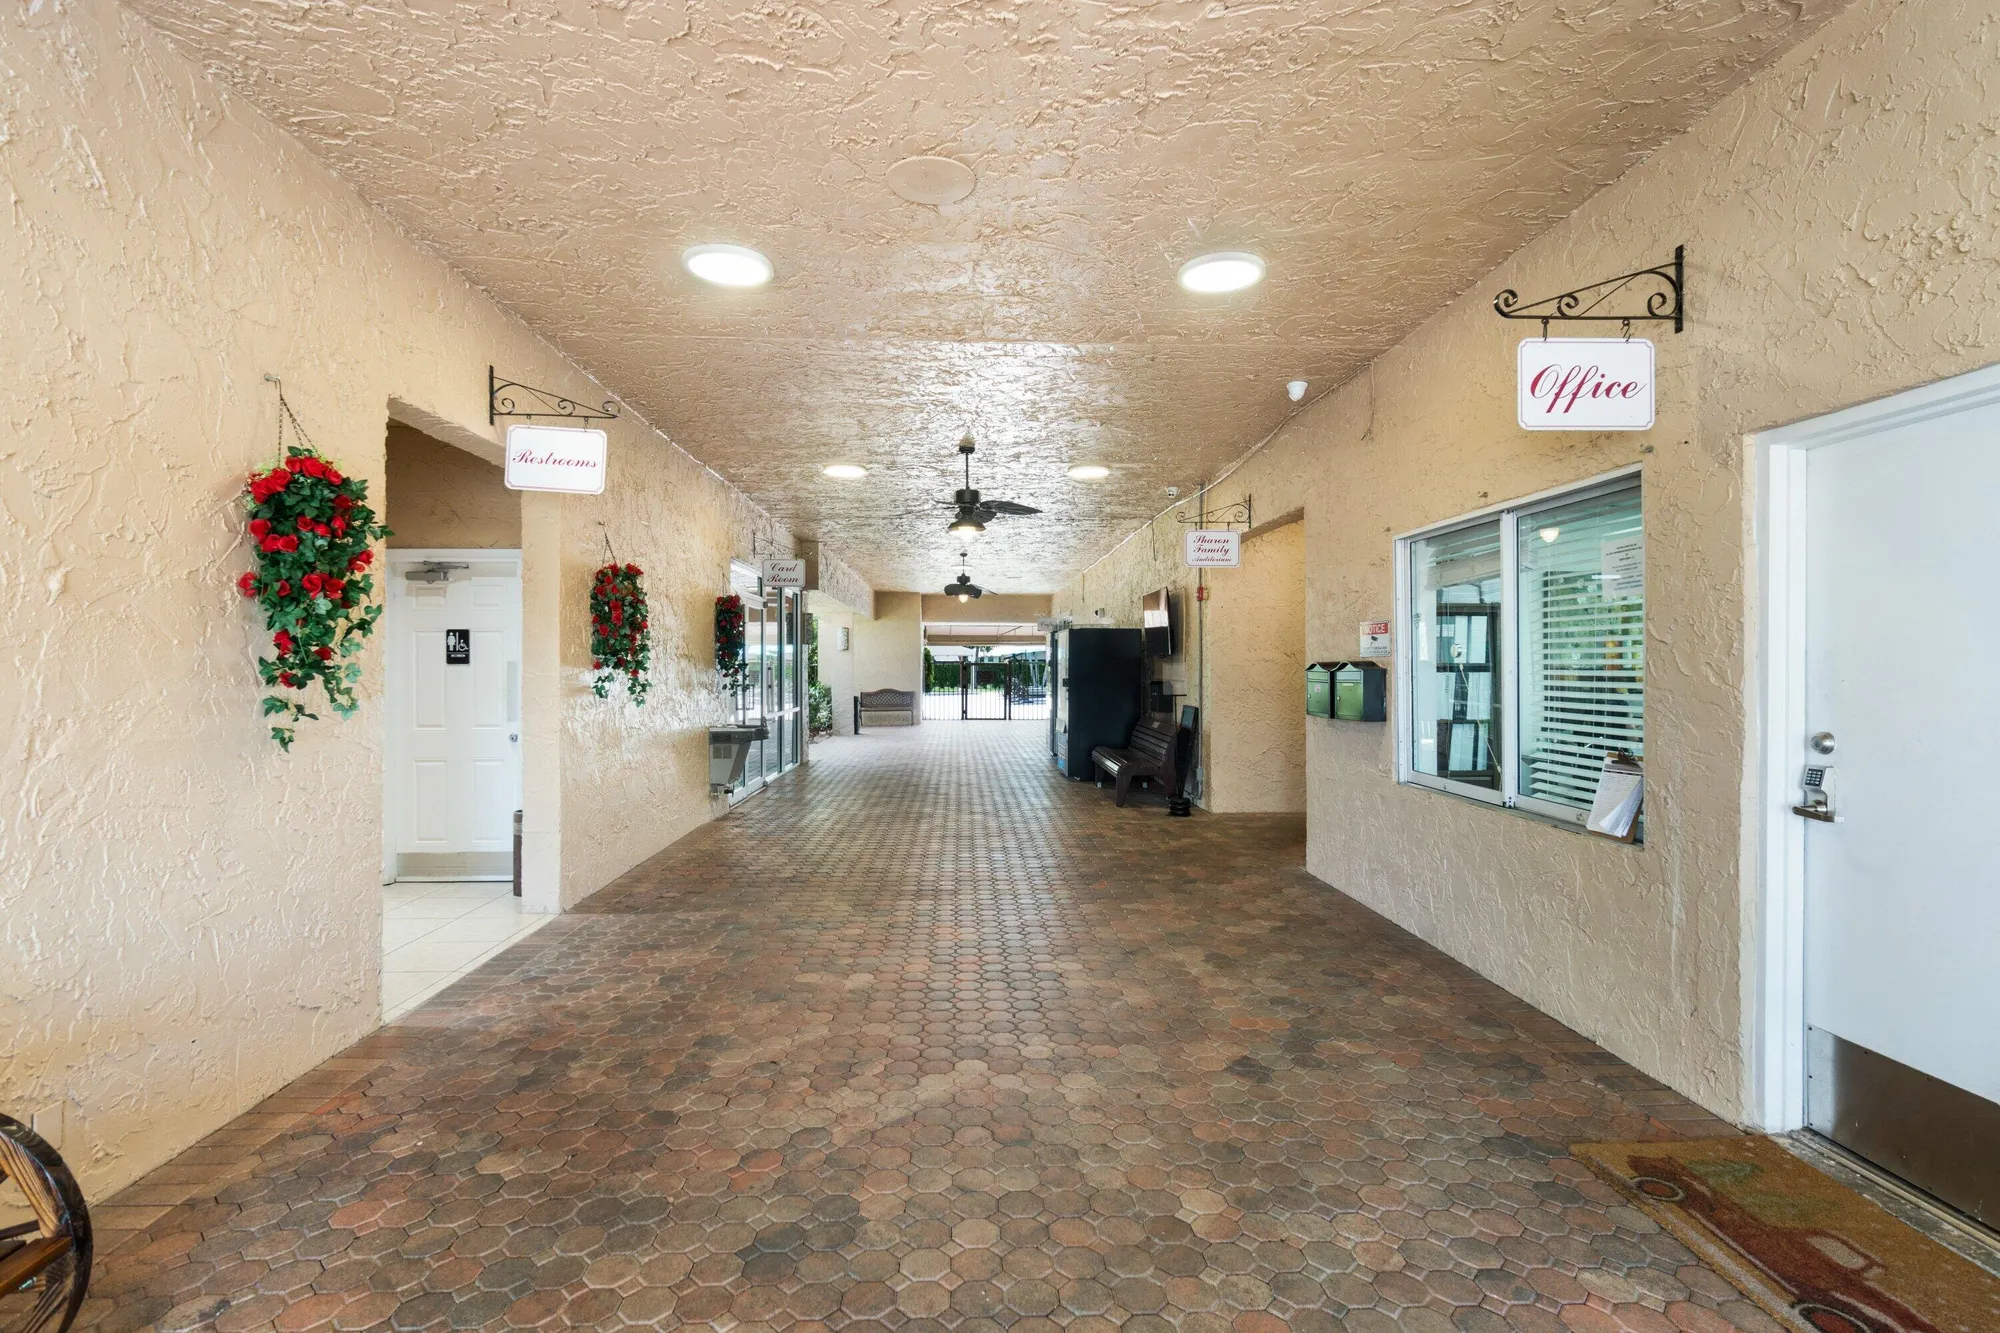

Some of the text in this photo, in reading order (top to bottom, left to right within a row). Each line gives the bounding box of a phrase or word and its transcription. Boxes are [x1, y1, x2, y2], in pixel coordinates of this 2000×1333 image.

[1530, 364, 1647, 413] Office
[512, 449, 598, 468] Restrooms
[1193, 534, 1229, 544] Sharon
[1193, 545, 1229, 556] Family
[770, 562, 798, 572] Card
[767, 573, 798, 583] Room
